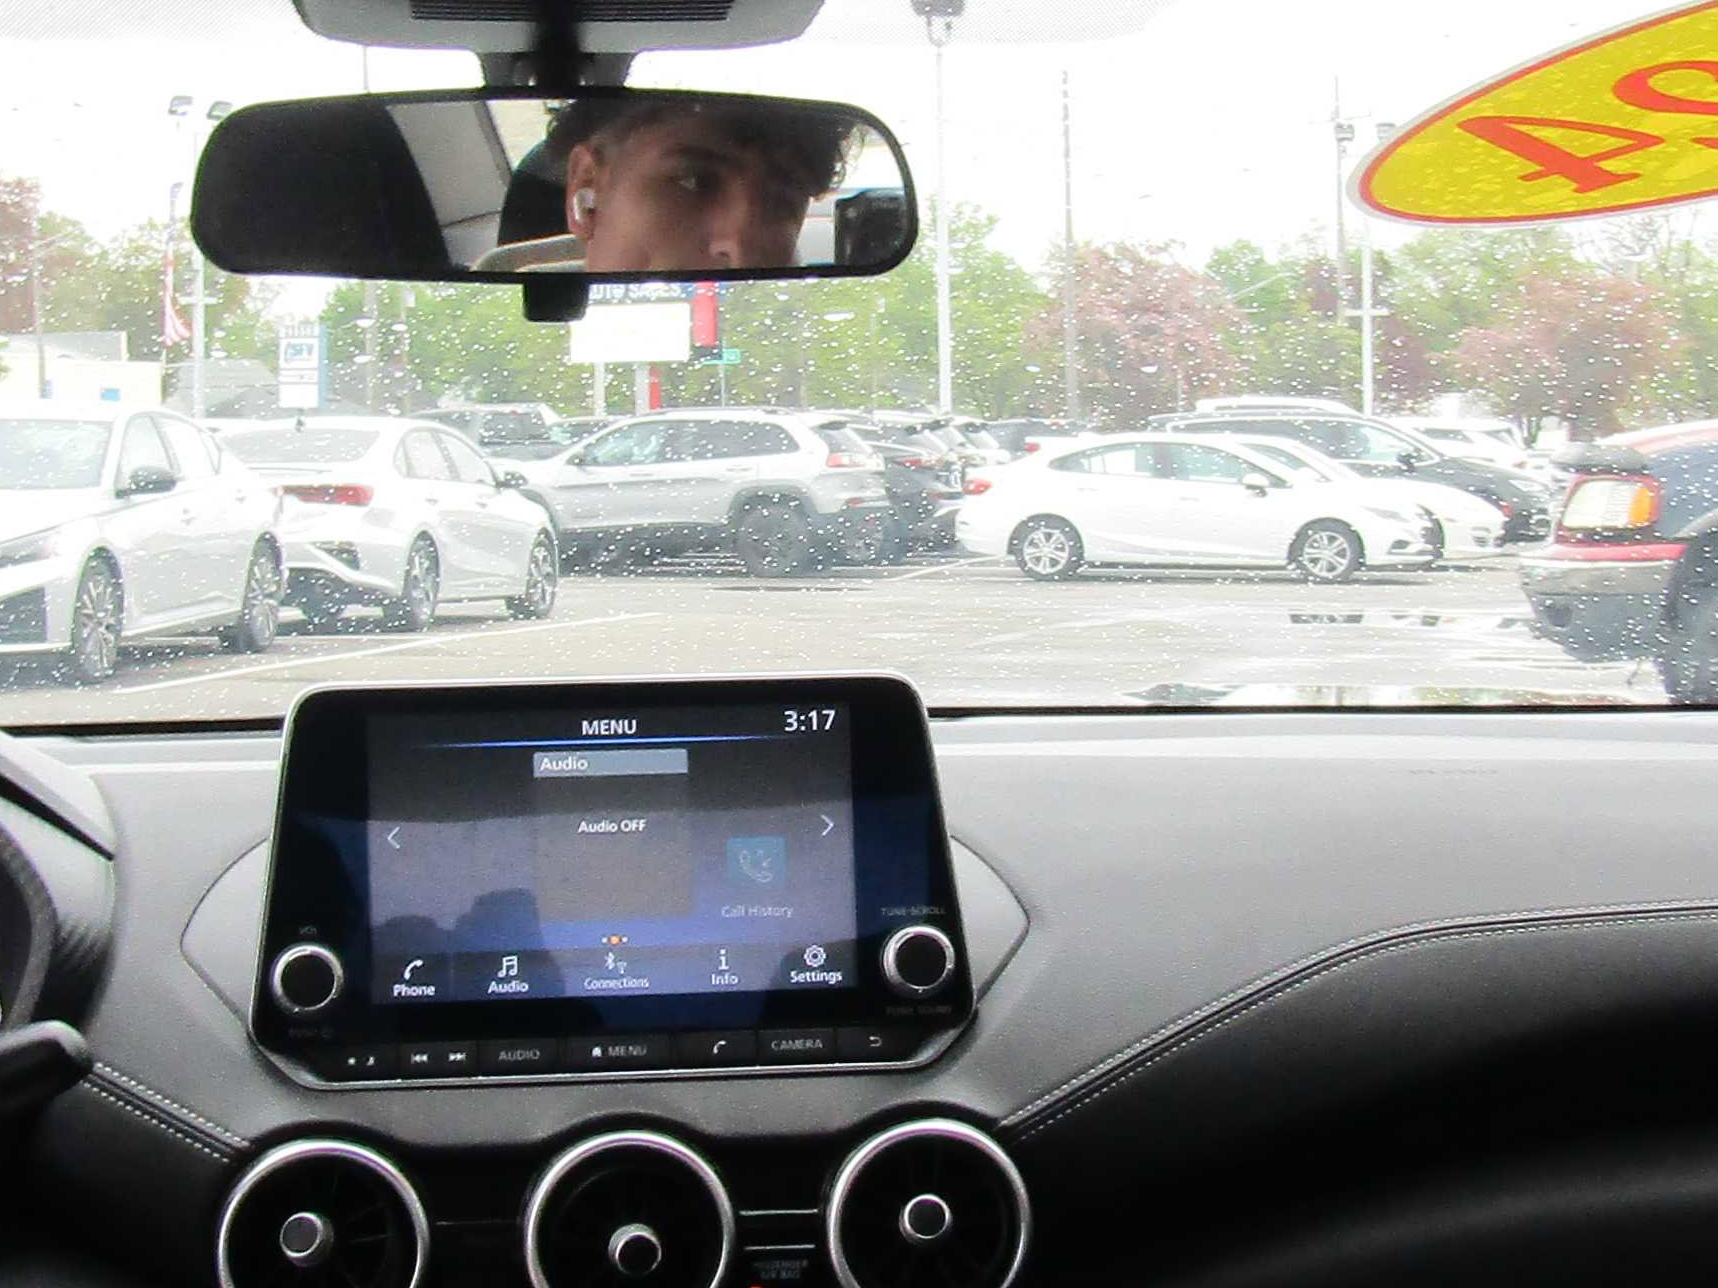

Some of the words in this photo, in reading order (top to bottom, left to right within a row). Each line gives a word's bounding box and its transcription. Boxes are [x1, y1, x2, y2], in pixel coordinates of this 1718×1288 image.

[582, 719, 637, 736] MENU
[784, 710, 836, 732] 3:17
[539, 756, 589, 772] Audio
[578, 820, 618, 833] Audio
[621, 819, 647, 832] OFF
[721, 905, 746, 919] Call
[748, 905, 794, 919] History
[583, 974, 650, 991] Connections
[711, 972, 738, 986] Info
[790, 968, 843, 985] Settings
[393, 983, 436, 999] Phone
[488, 978, 529, 994] Audio
[608, 1044, 648, 1058] MENU
[771, 1038, 824, 1052] CAMERA
[498, 1048, 541, 1062] AUDIO
